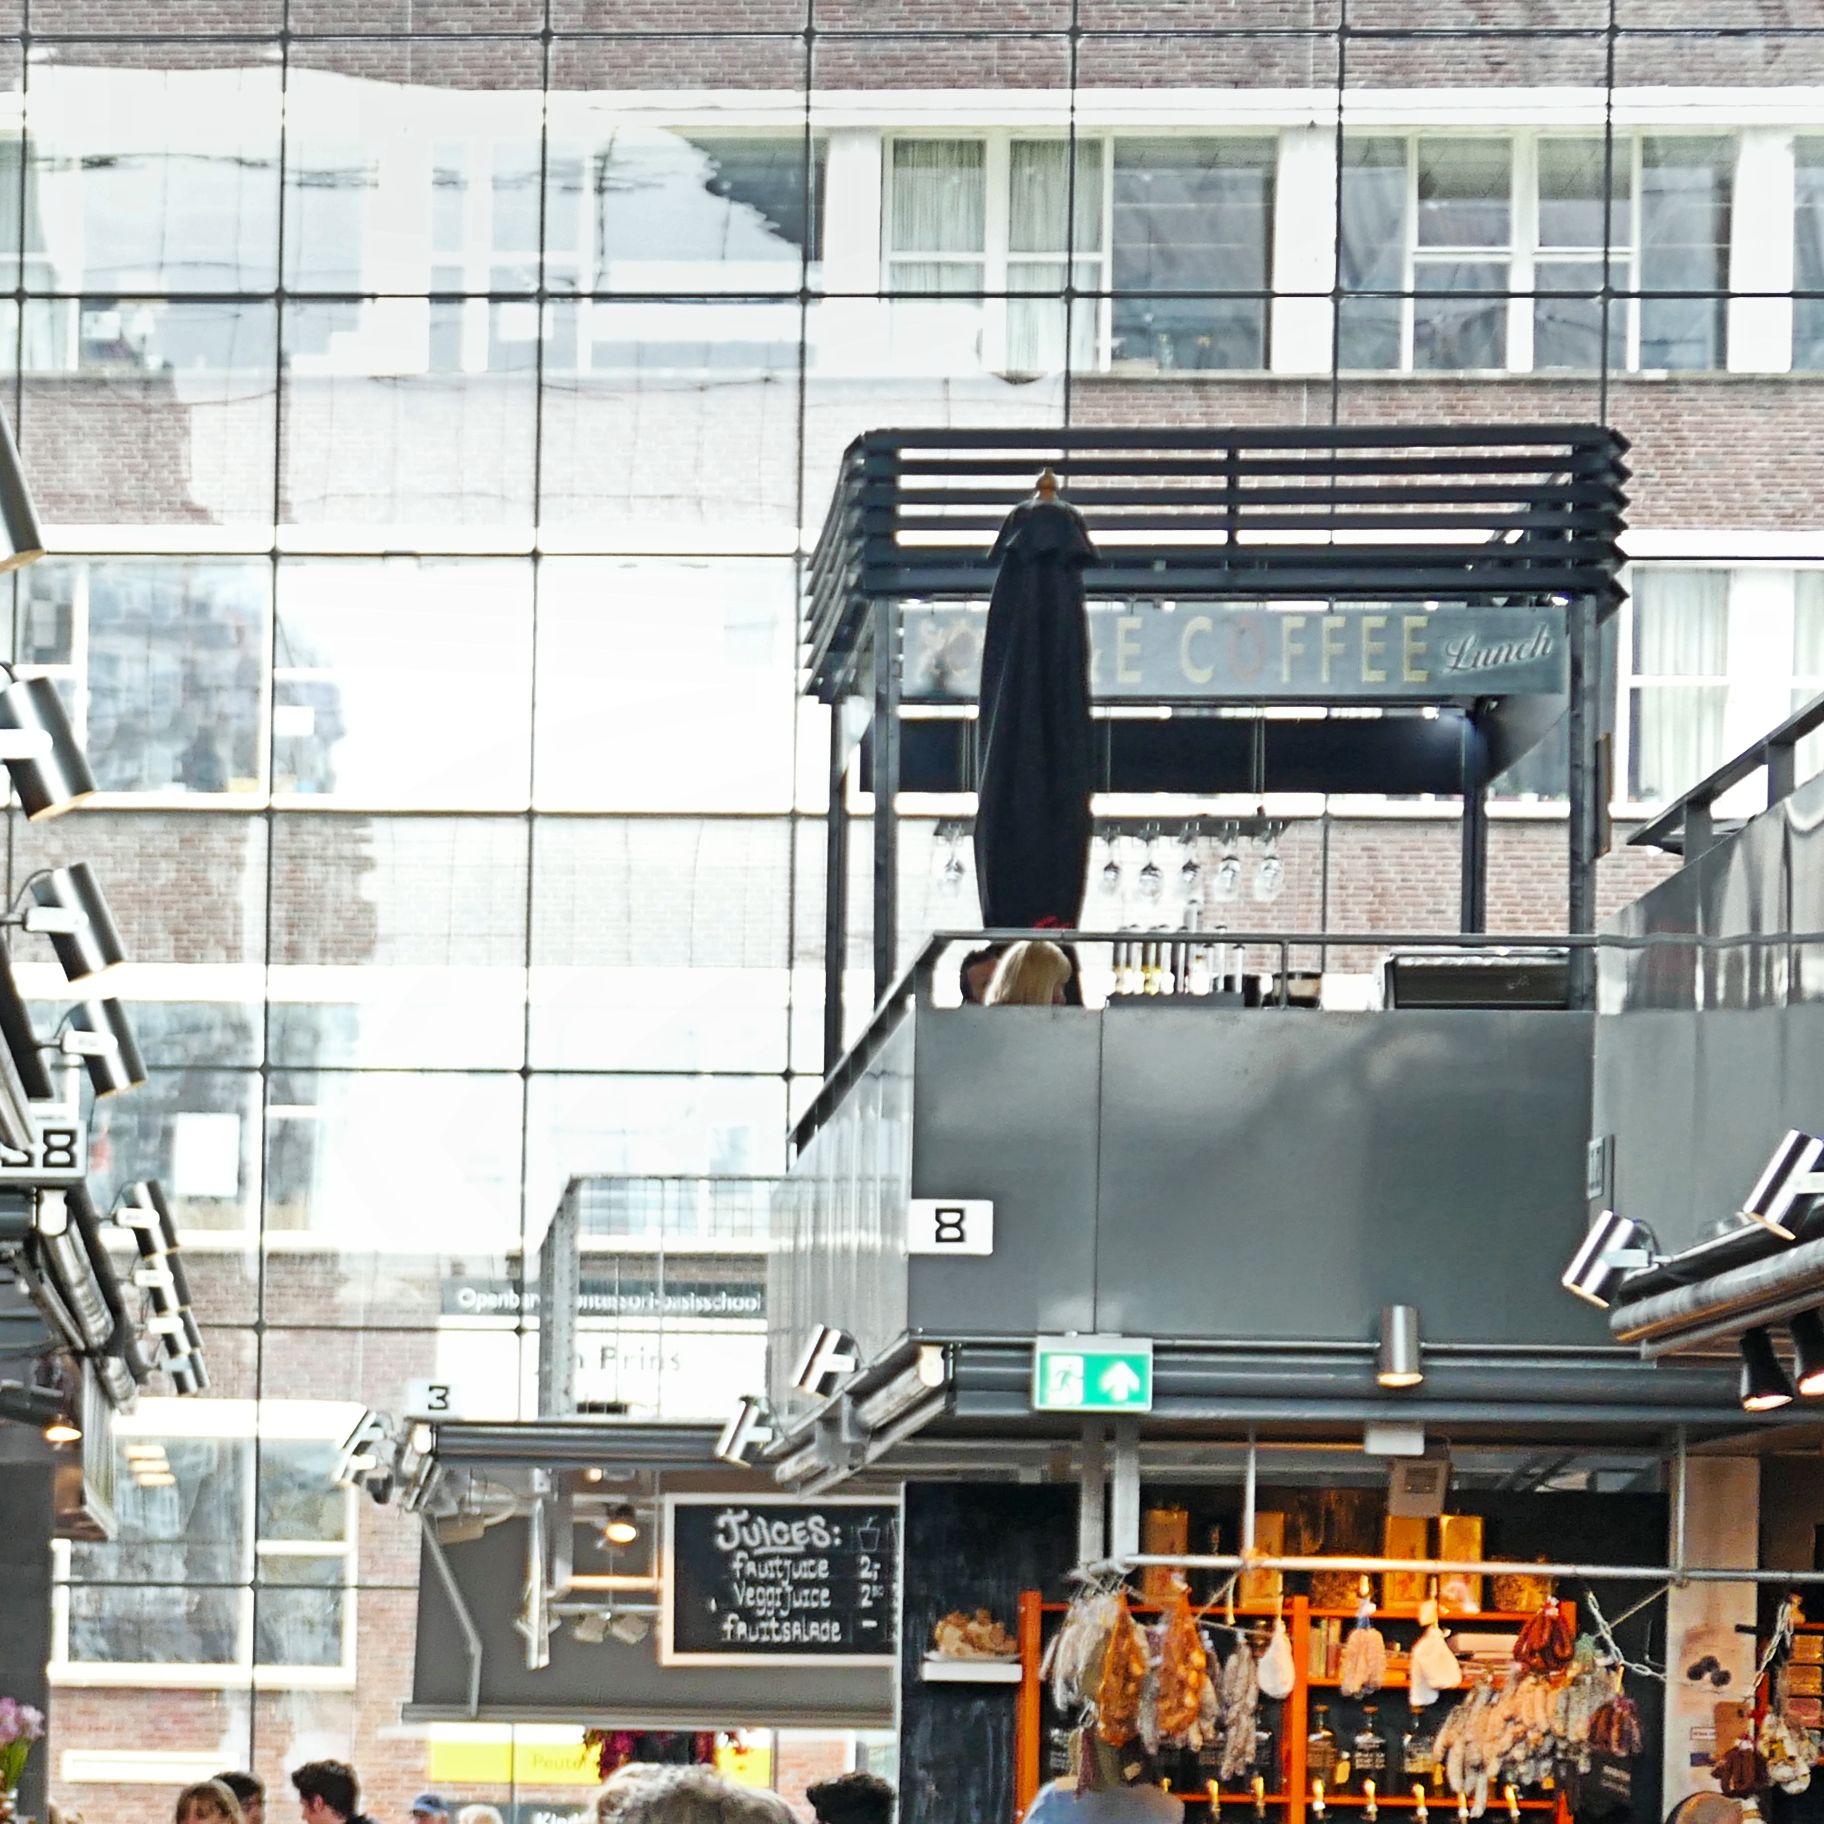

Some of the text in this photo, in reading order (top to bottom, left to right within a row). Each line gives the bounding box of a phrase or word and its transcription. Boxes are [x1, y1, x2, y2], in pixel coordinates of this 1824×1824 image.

[1179, 614, 1430, 685] COFFEE
[1440, 622, 1554, 675] Lunch
[936, 1208, 966, 1244] 8
[427, 1385, 451, 1411] 3
